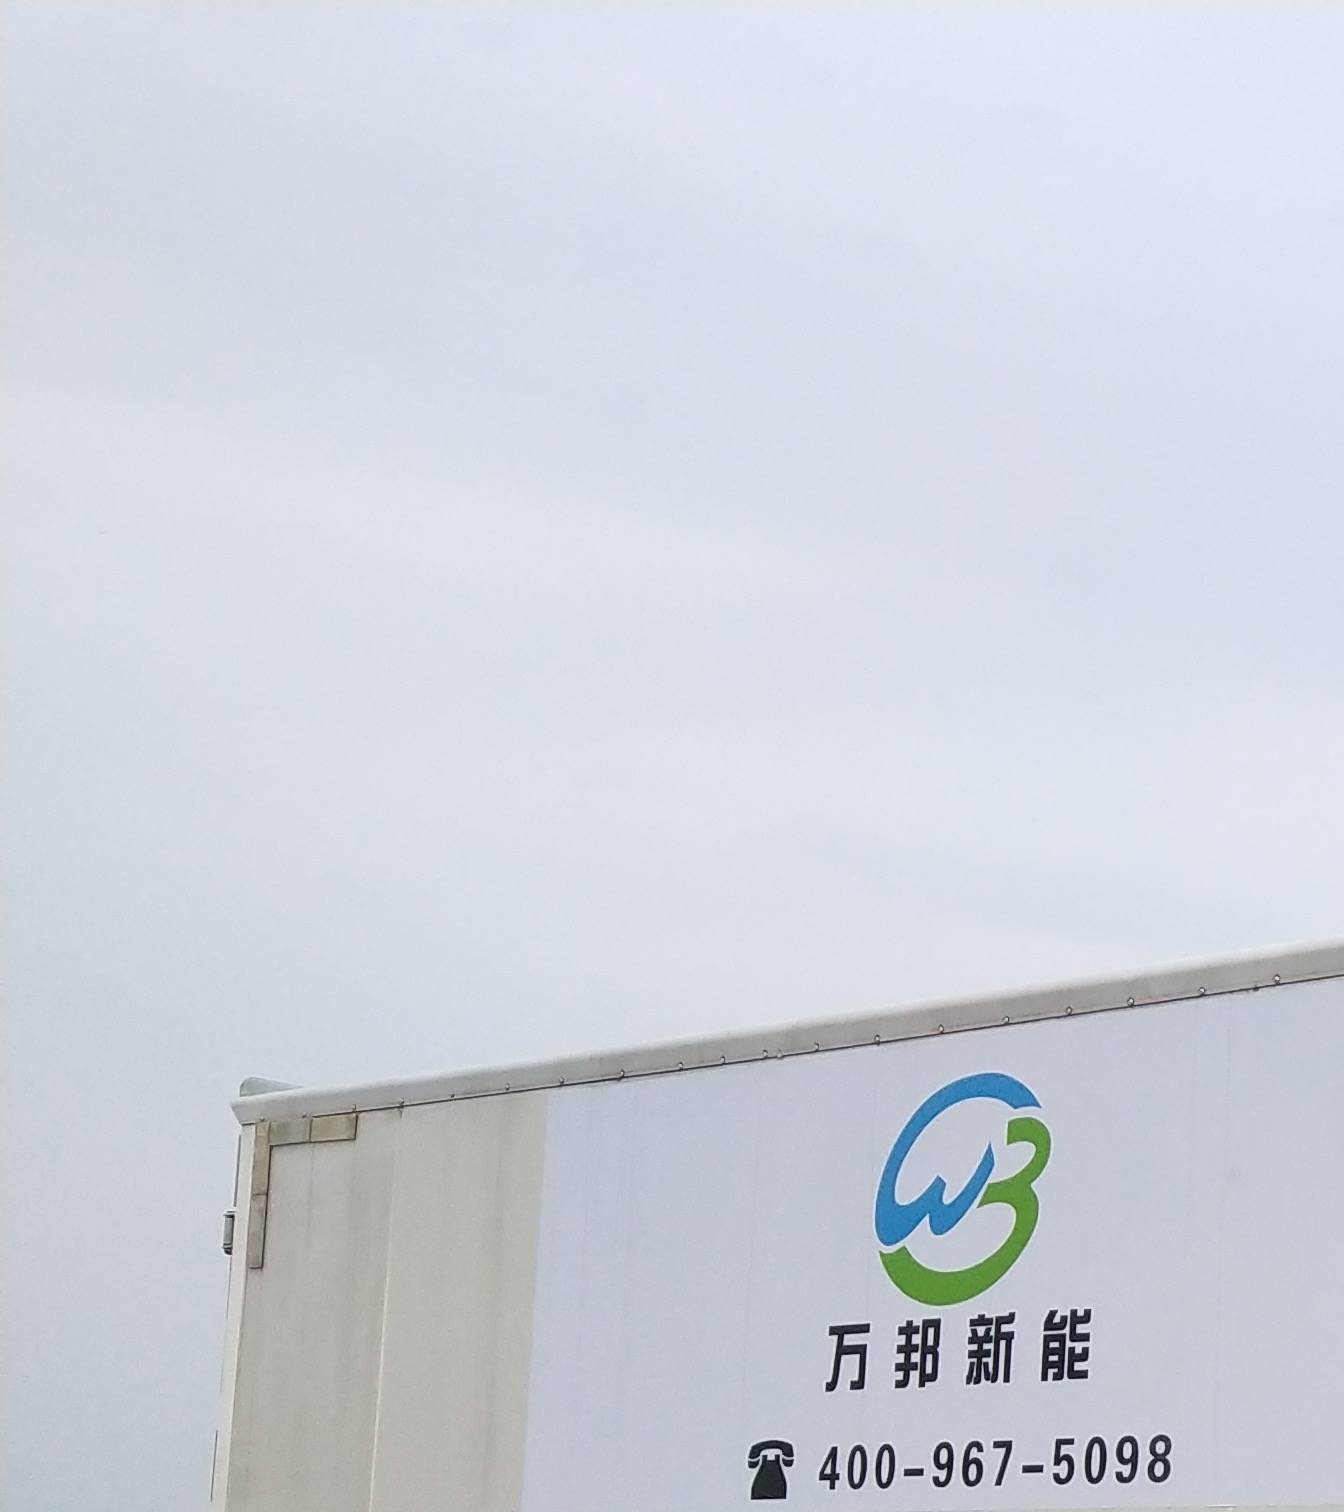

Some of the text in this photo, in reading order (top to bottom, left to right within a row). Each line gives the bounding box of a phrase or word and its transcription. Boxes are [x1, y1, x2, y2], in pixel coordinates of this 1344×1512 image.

[824, 1308, 1093, 1393] 万邦新能
[818, 1434, 1172, 1490] 400-967-5098
